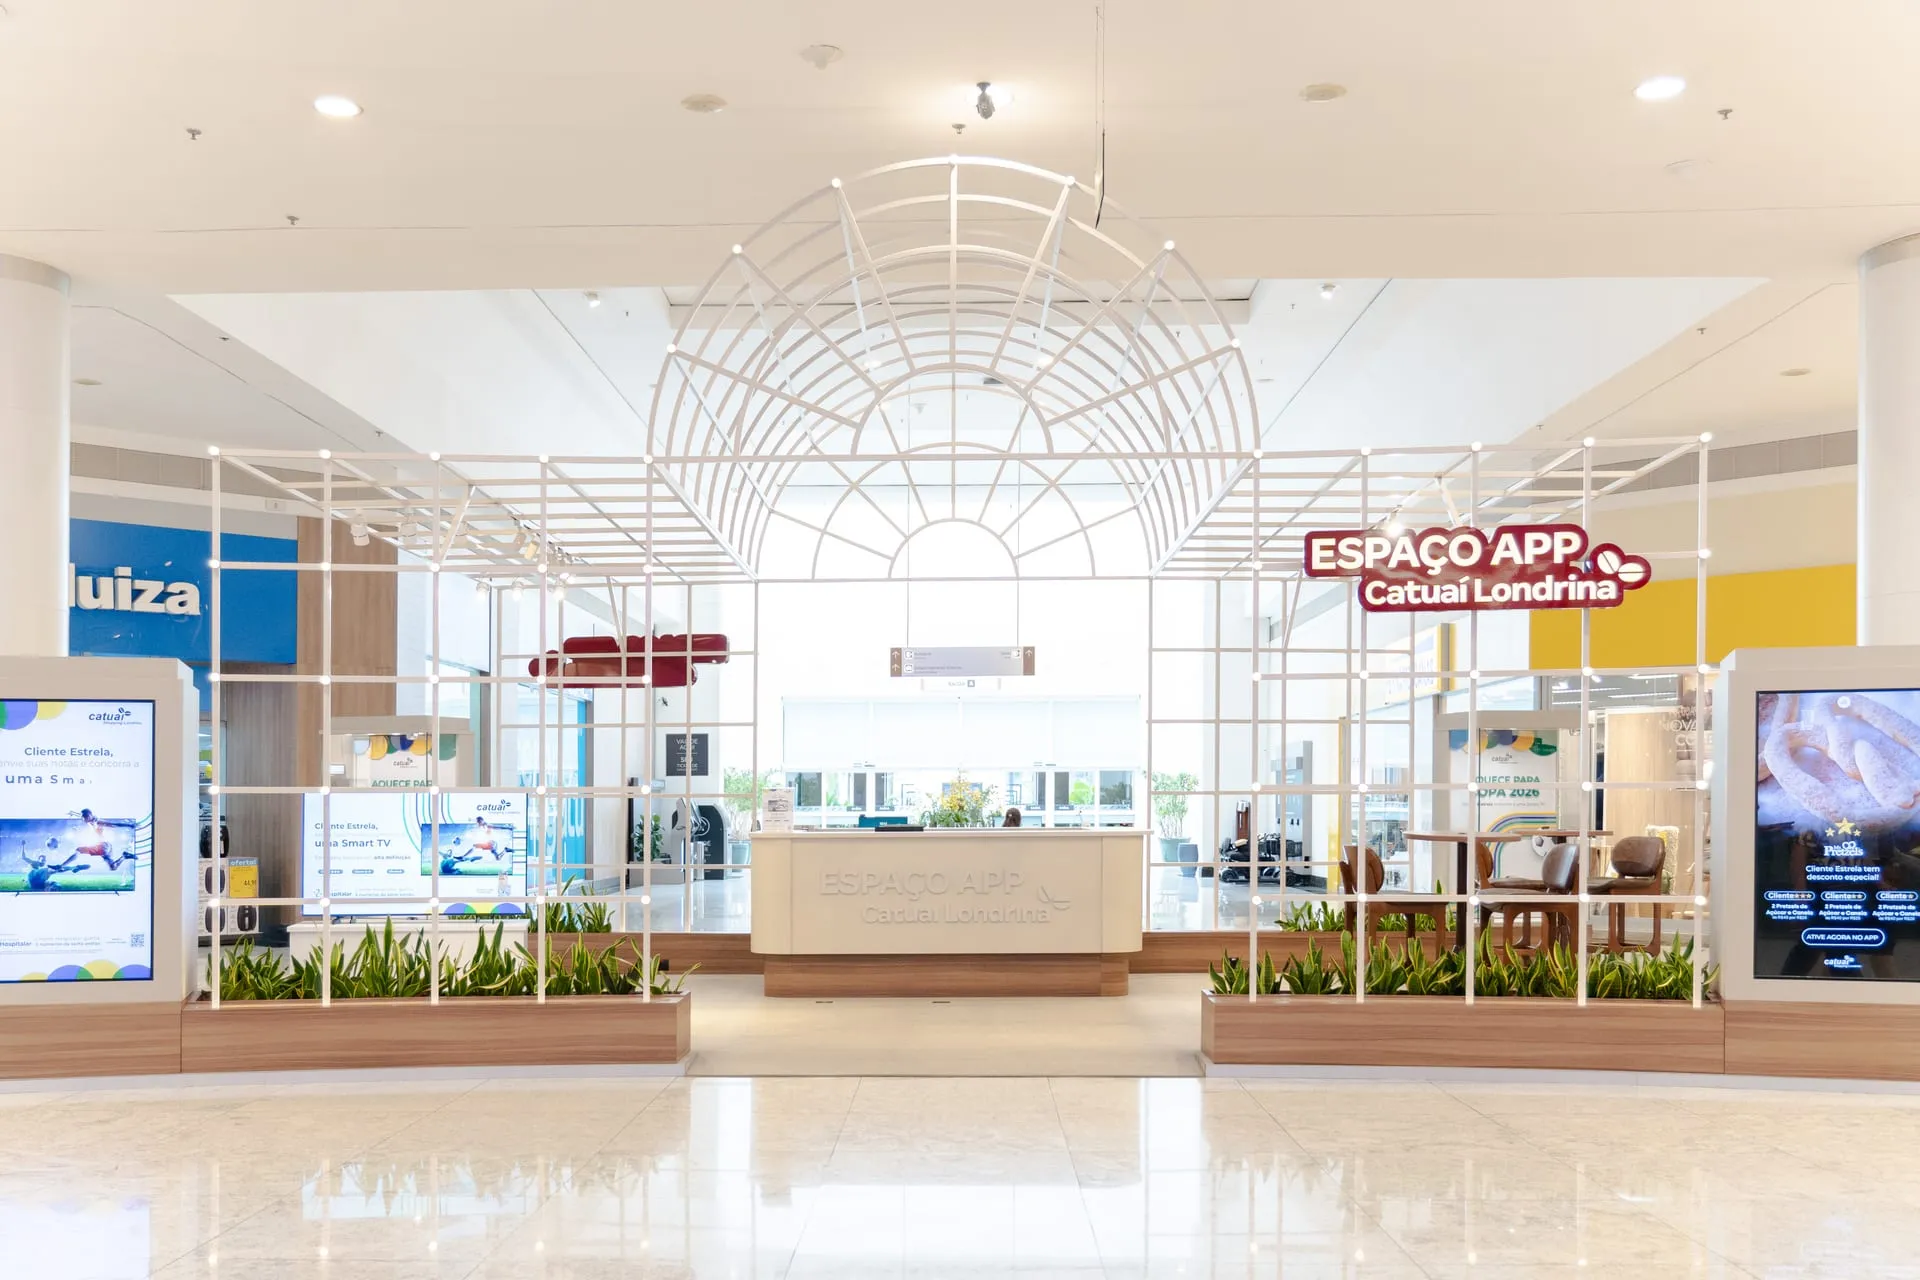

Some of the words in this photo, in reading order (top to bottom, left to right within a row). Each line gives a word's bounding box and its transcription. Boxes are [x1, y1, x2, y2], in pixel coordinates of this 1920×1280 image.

[1311, 533, 1483, 575] ESPAÇO
[1490, 531, 1582, 566] APP
[1364, 576, 1470, 605] Catuaí
[1474, 575, 1617, 603] Londrina
[24, 747, 67, 756] Cliente
[70, 747, 114, 757] Estrela,
[5, 775, 43, 784] uma
[1509, 789, 1540, 797] 2026
[314, 822, 345, 830] Clnte
[347, 822, 378, 831] Estrela,
[341, 839, 374, 848] Smart
[377, 839, 391, 848] TV
[1844, 874, 1880, 882] especial!
[820, 871, 949, 901] ESPAÇO
[957, 871, 1024, 895] APP
[1824, 892, 1851, 900] Cliente
[944, 902, 1051, 924] Londrina
